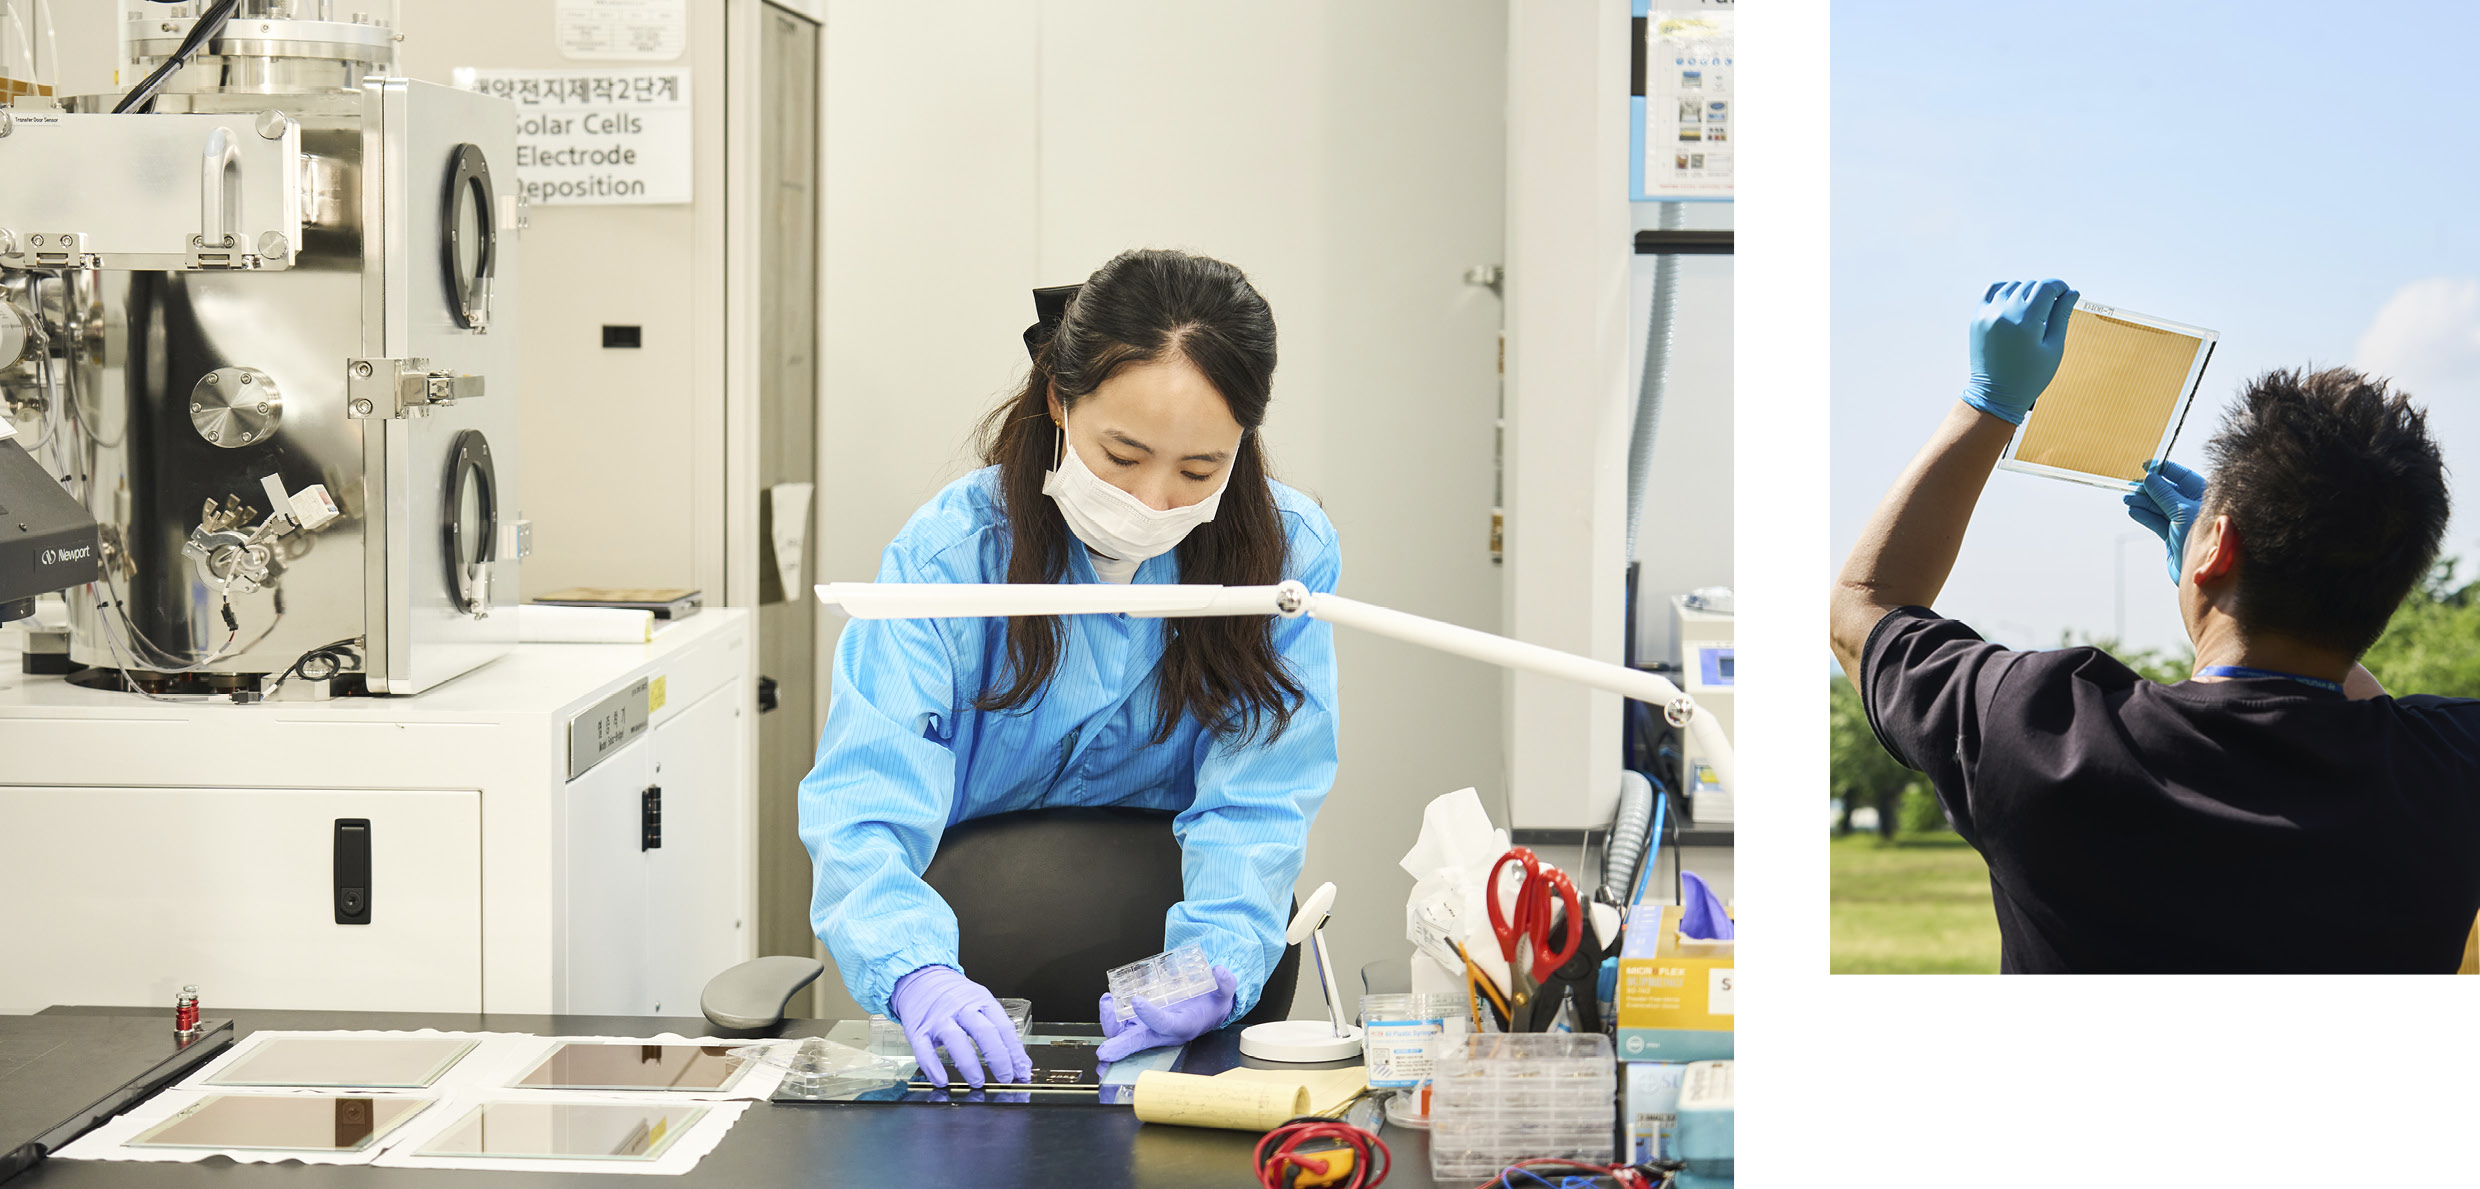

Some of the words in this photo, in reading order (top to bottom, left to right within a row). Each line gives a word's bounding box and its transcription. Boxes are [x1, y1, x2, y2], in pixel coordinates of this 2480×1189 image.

[583, 113, 643, 135] Cells
[517, 145, 636, 167] Electrode
[58, 545, 90, 562] Newport
